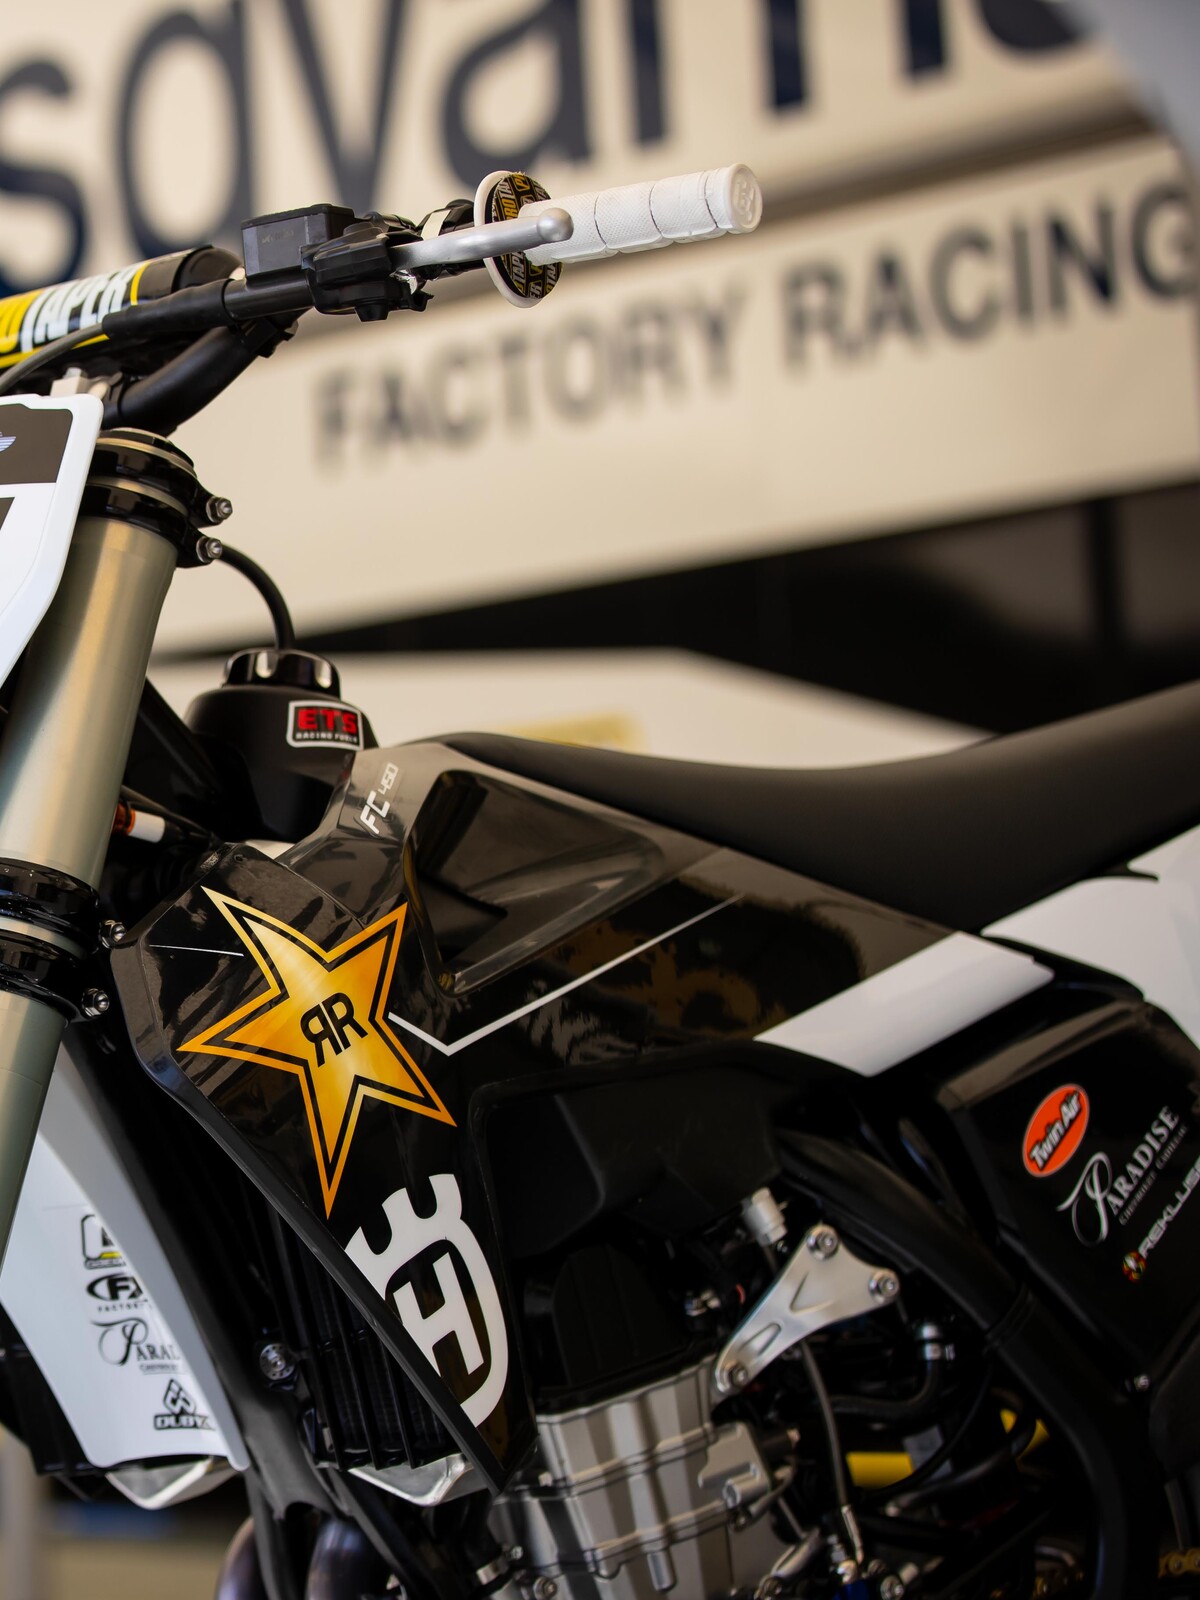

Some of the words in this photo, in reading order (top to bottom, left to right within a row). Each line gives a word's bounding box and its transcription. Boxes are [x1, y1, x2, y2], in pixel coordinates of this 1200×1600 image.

[314, 294, 744, 472] FACTORY
[782, 182, 1198, 364] RACING
[295, 732, 332, 740] RACING
[296, 708, 358, 735] ETS
[360, 790, 390, 835] FC
[378, 762, 399, 795] 450
[1030, 1119, 1065, 1169] Twin
[1060, 1090, 1081, 1129] Air
[1056, 1105, 1180, 1247] PARADISE
